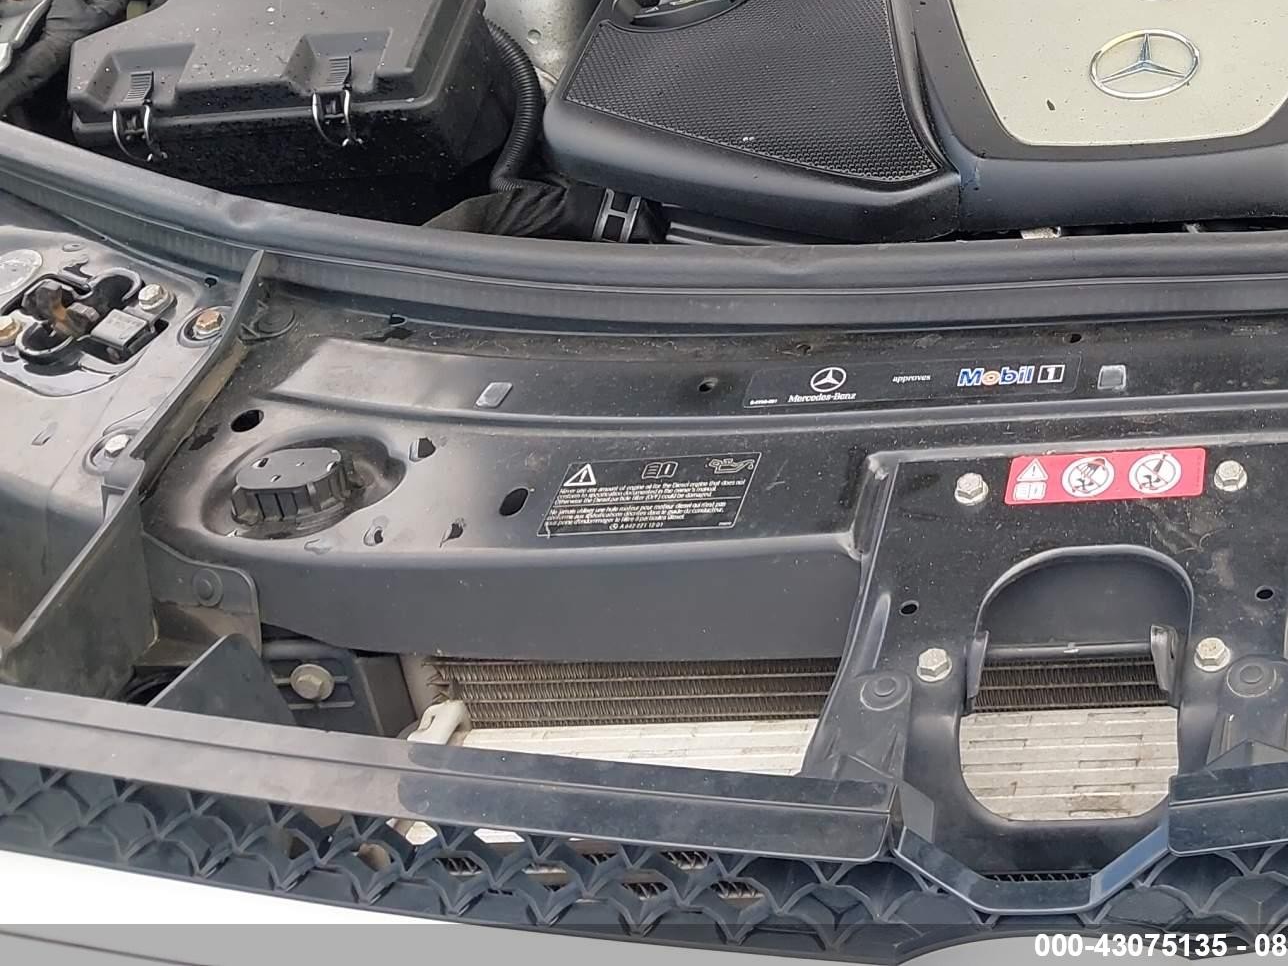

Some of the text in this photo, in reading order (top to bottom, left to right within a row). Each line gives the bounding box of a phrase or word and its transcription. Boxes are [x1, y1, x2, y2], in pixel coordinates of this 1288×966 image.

[892, 374, 931, 384] approves
[958, 366, 1035, 386] Mobil
[787, 392, 857, 403] Mercedes-Benz
